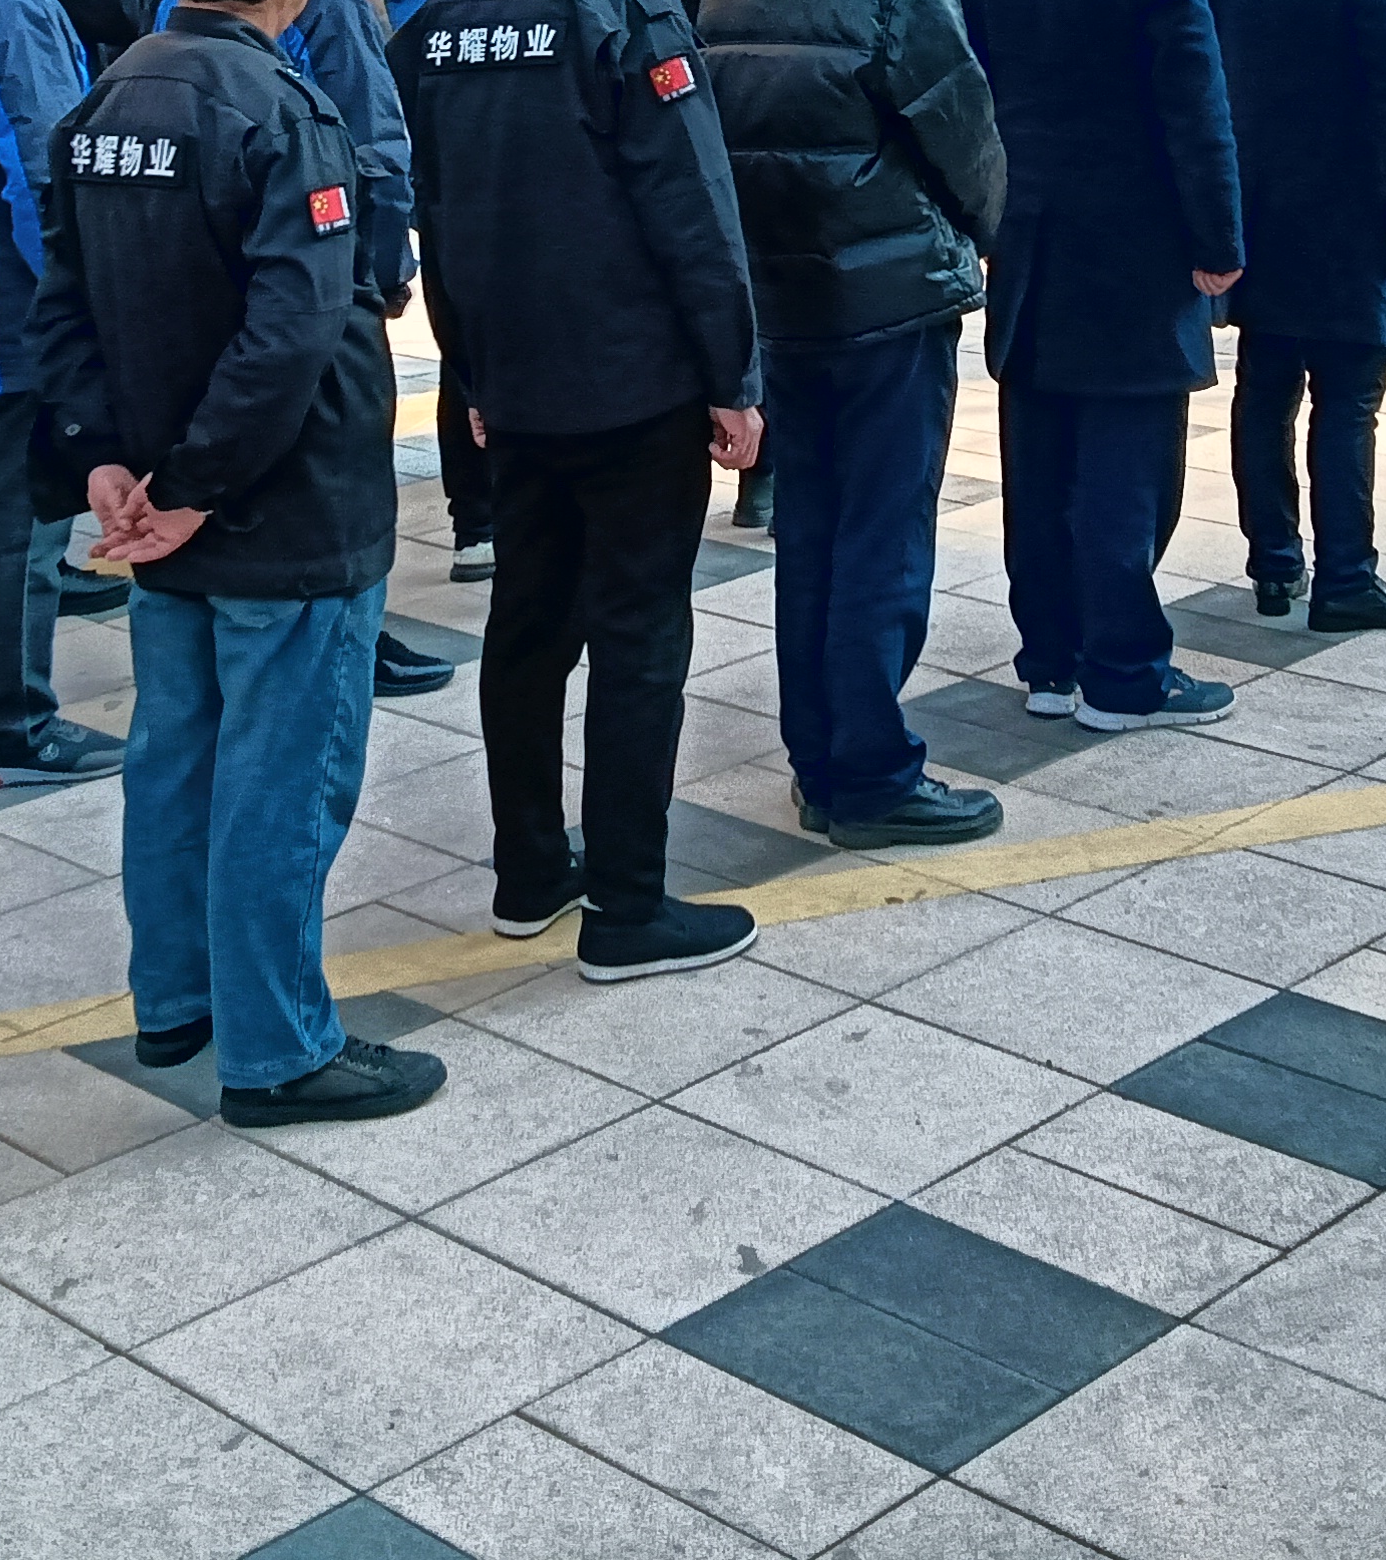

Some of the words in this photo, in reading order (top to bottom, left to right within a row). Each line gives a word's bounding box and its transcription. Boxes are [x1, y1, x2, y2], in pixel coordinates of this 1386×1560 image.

[426, 23, 556, 66] 华耀物业
[69, 133, 177, 177] 华耀物业
